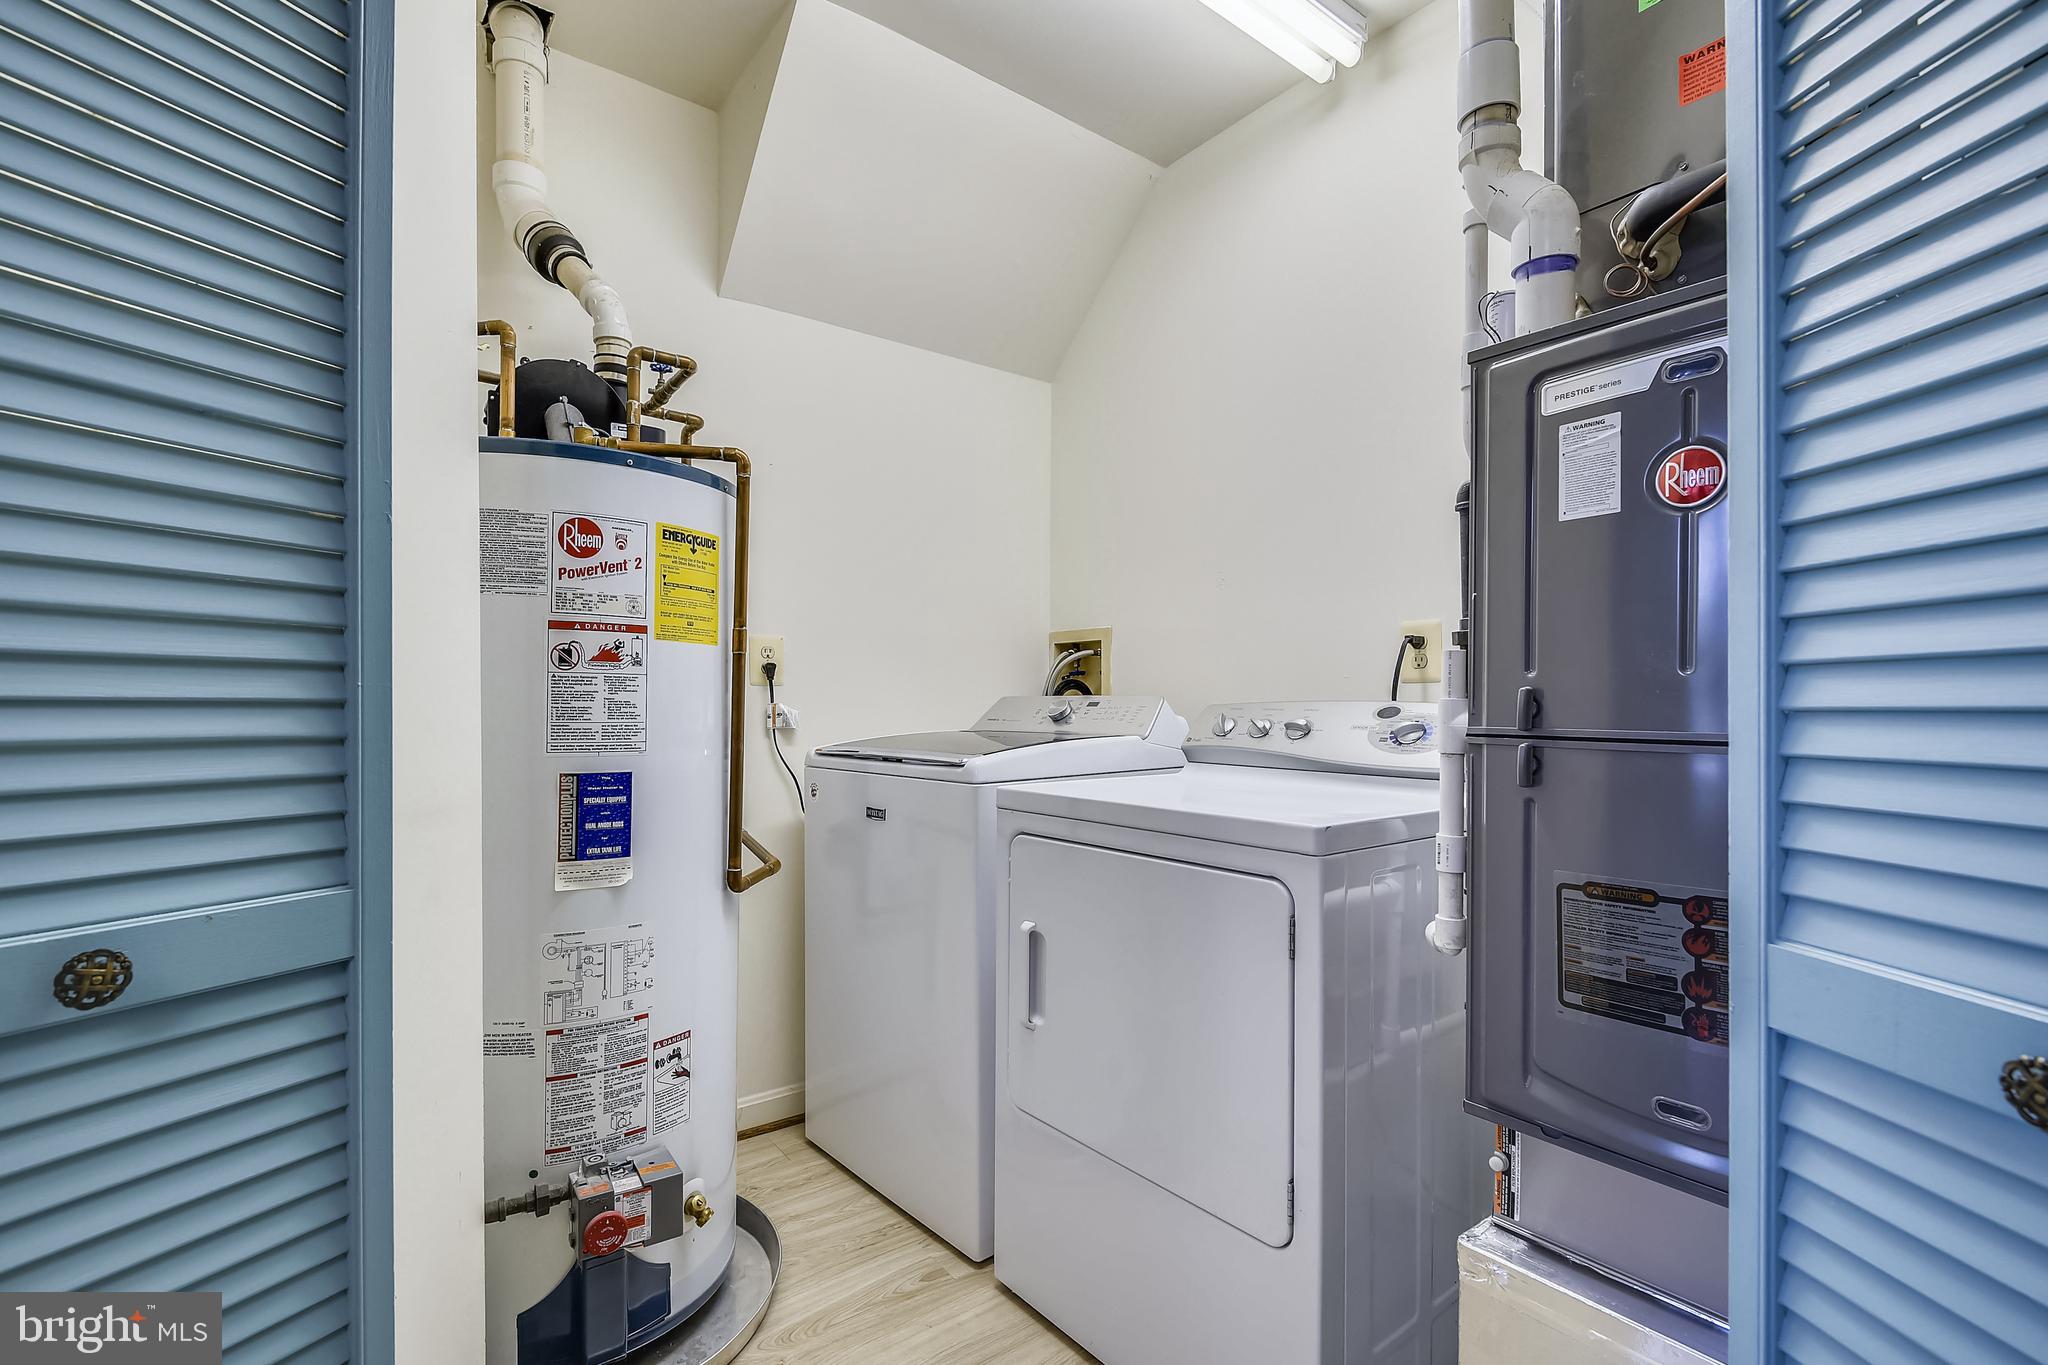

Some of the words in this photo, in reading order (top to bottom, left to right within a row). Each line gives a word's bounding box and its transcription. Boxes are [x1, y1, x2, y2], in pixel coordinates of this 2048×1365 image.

[1554, 385, 1595, 402] PRESTIGE
[1598, 379, 1622, 390] series
[1572, 418, 1606, 431] WARNING
[1665, 453, 1720, 498] Rheem
[563, 518, 602, 553] Rheem
[662, 528, 717, 550] ENERGYGUIDE
[634, 557, 642, 570] 2
[585, 623, 627, 632] DANGER
[1601, 888, 1643, 901] WARNING
[662, 1031, 689, 1047] DANGER
